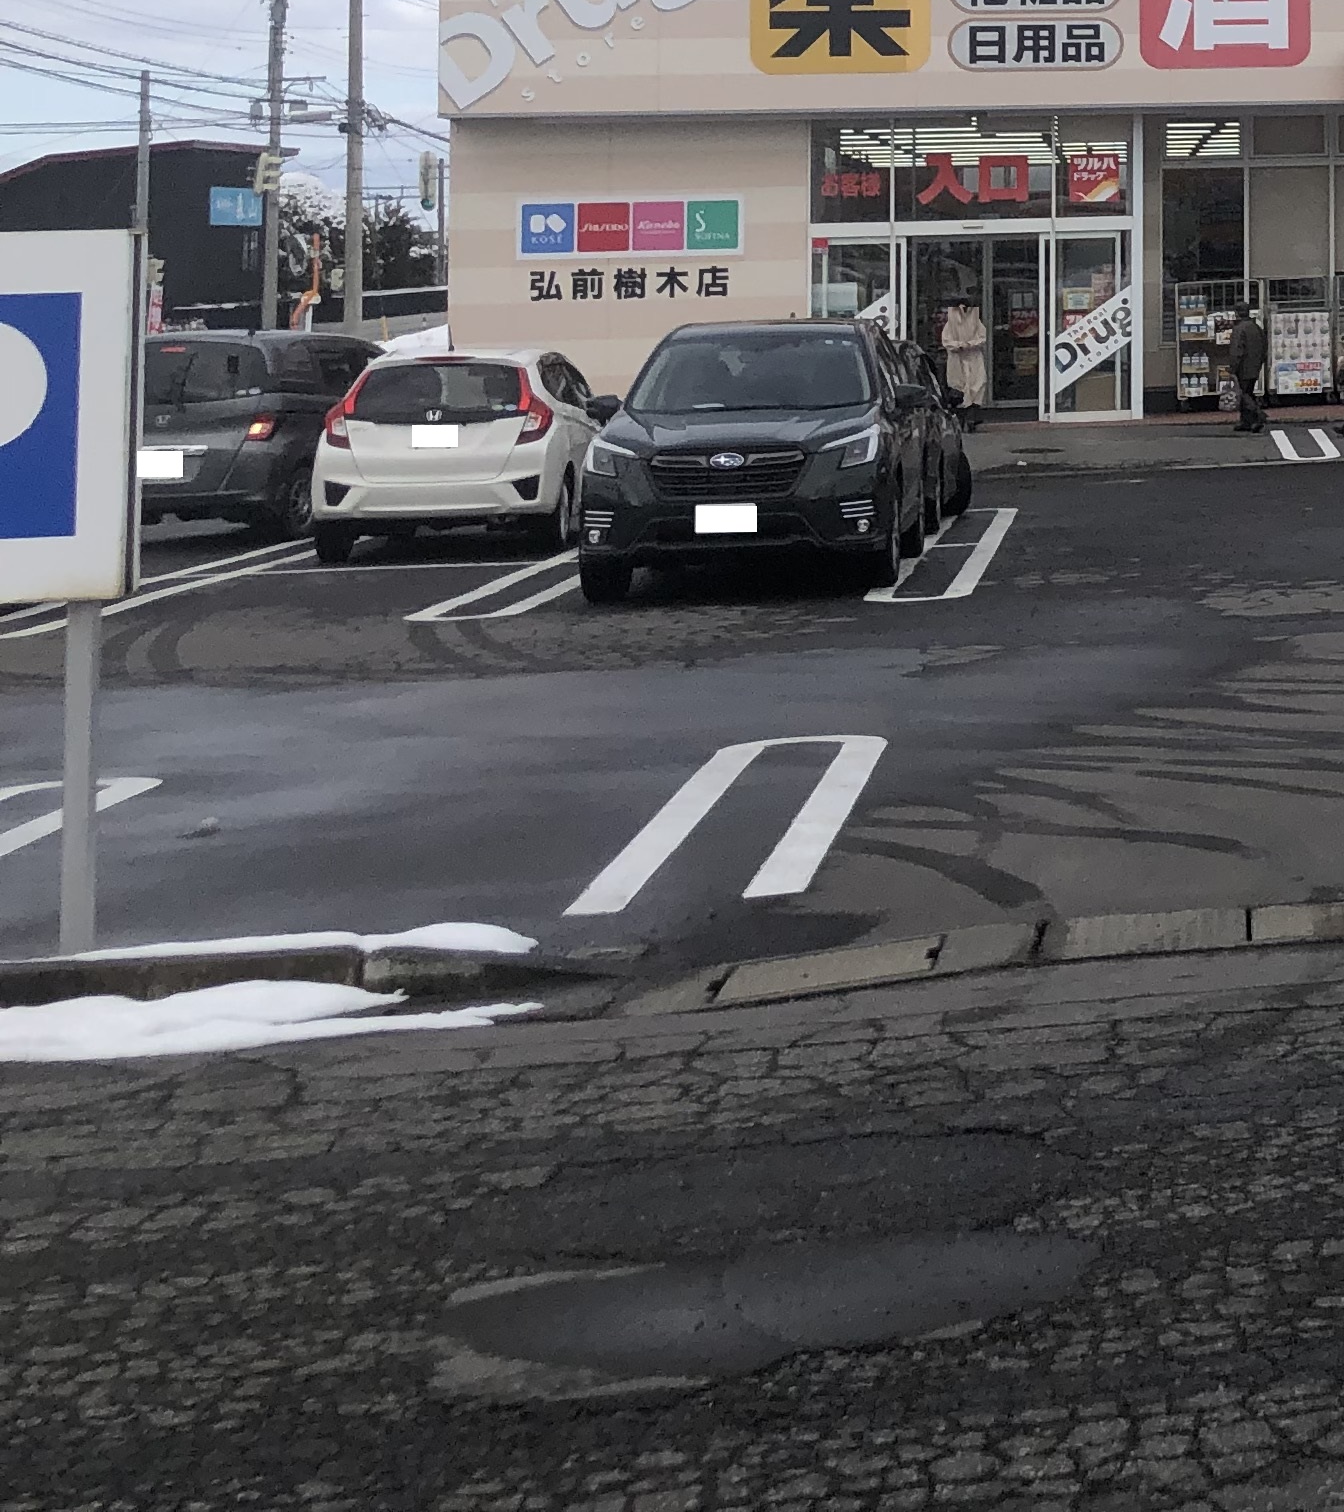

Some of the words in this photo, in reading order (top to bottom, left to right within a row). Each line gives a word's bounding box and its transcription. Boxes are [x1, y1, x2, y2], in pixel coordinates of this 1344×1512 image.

[521, 16, 645, 102] store
[968, 23, 1106, 65] 日用品
[1073, 156, 1116, 170] ツルハ
[821, 173, 881, 197] お客様
[917, 153, 1029, 205] 入口
[578, 222, 630, 233] SHISEIDO
[637, 219, 681, 230] Kanebo
[530, 265, 730, 301] 弘前樹木店
[1086, 307, 1108, 325] Real
[1055, 297, 1132, 374] Drug
